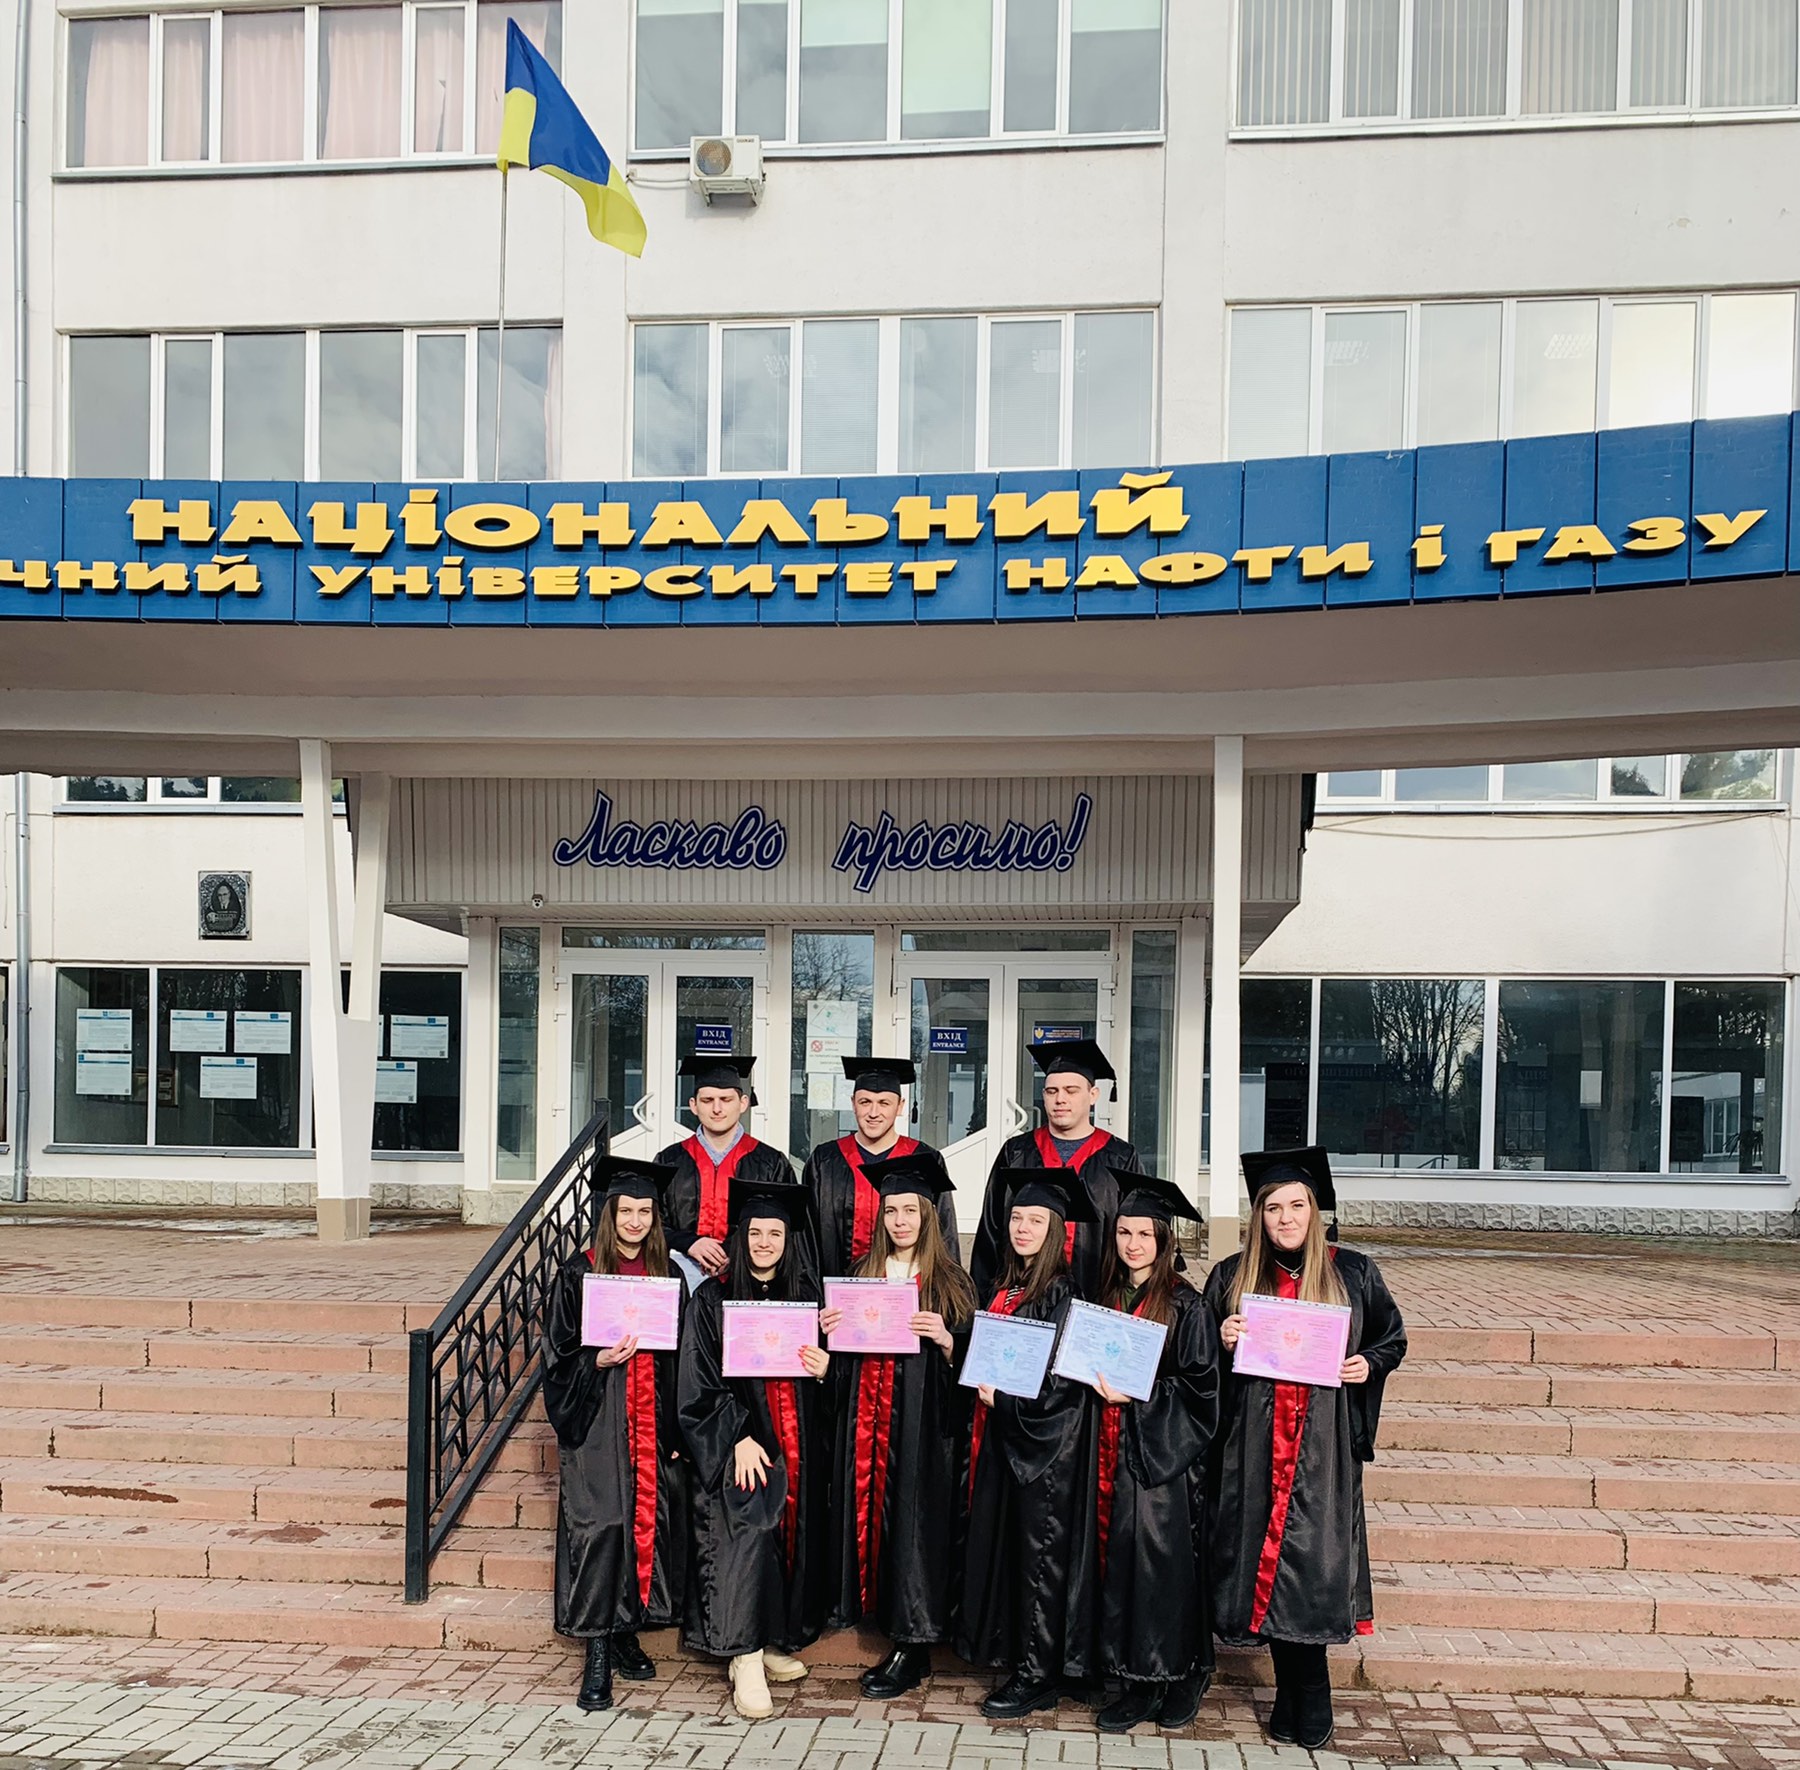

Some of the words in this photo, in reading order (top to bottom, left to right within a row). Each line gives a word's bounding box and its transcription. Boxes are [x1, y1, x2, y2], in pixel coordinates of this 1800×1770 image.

[126, 471, 1190, 553] НАЦІОНАЛЬНИЙ
[309, 556, 957, 597] УНІВЕРСИТЕТ
[1002, 540, 1374, 591] НАФТИ
[1486, 509, 1768, 563] ГАЗУ
[553, 789, 787, 870] Ласкаво
[832, 793, 1093, 893] просимо!
[702, 1030, 726, 1039] ВХІД
[937, 1032, 962, 1041] ВХІД
